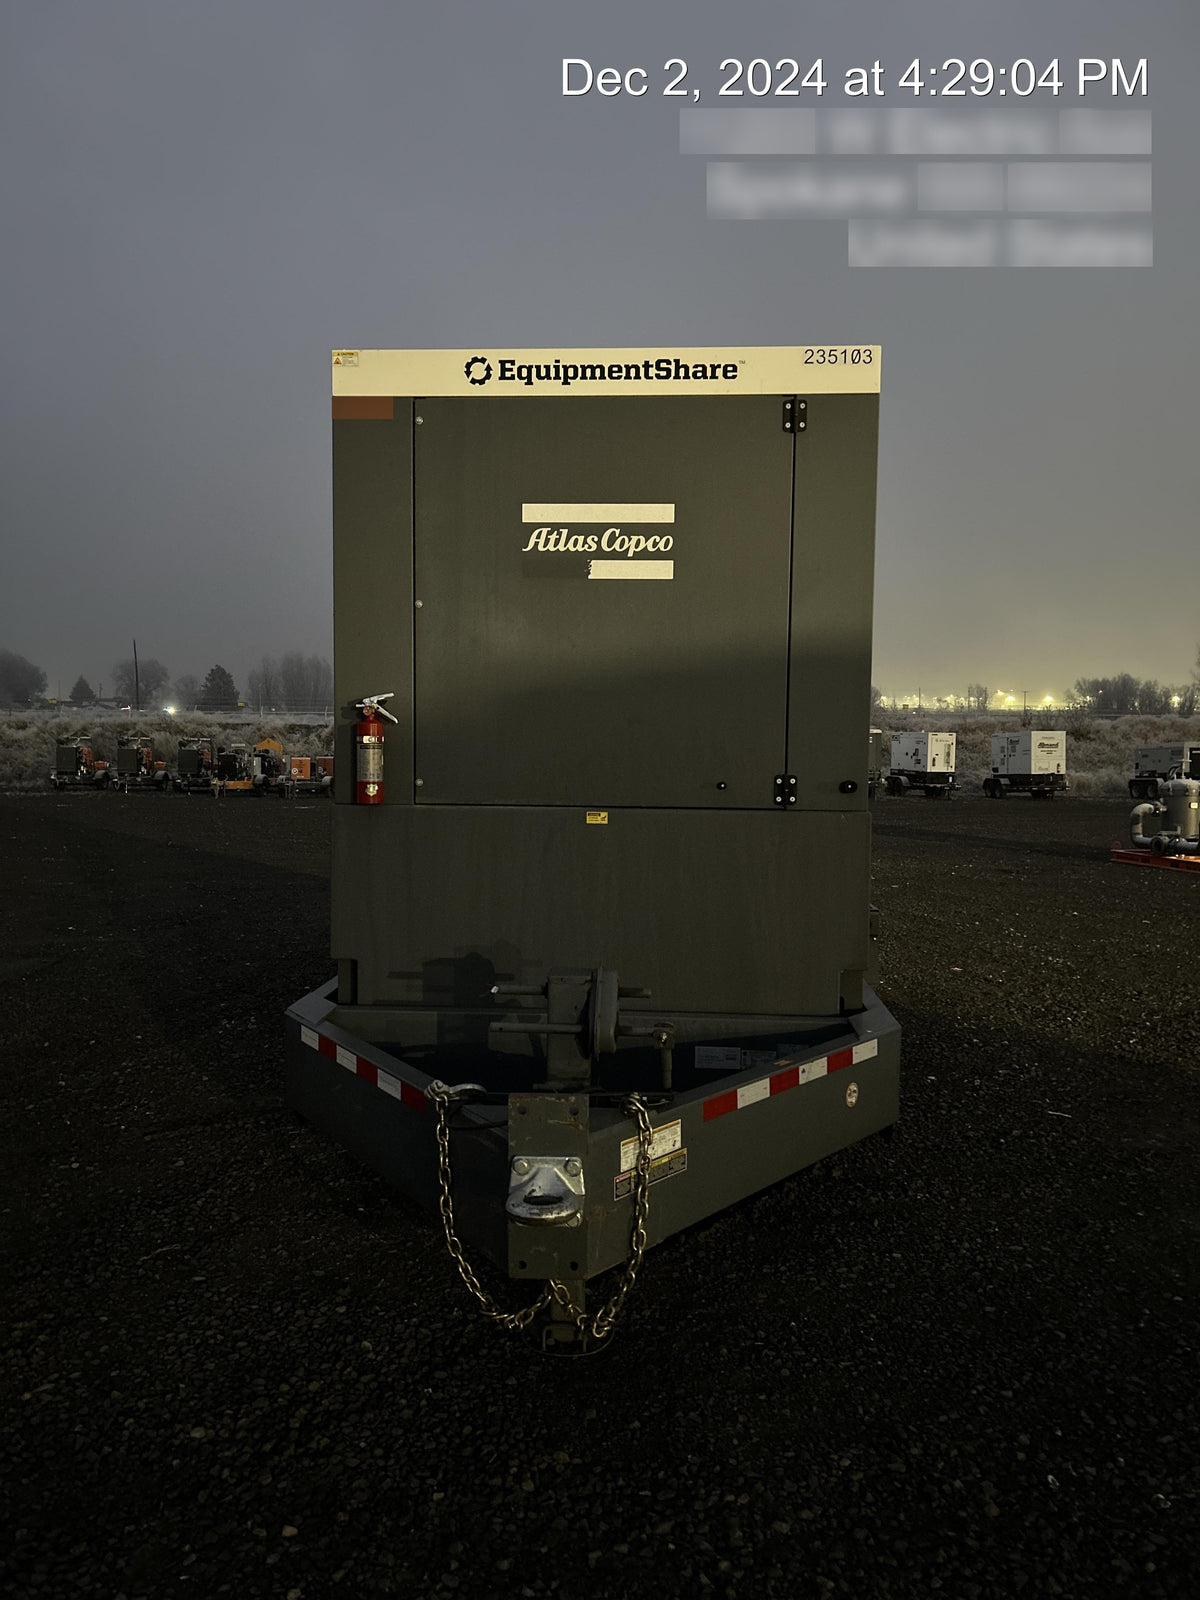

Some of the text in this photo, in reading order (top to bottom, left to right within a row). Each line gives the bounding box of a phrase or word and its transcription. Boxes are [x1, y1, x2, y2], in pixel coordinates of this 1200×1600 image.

[803, 348, 873, 365] 235103
[498, 358, 738, 386] EquipmentShare
[522, 527, 674, 557] Atlas Copco
